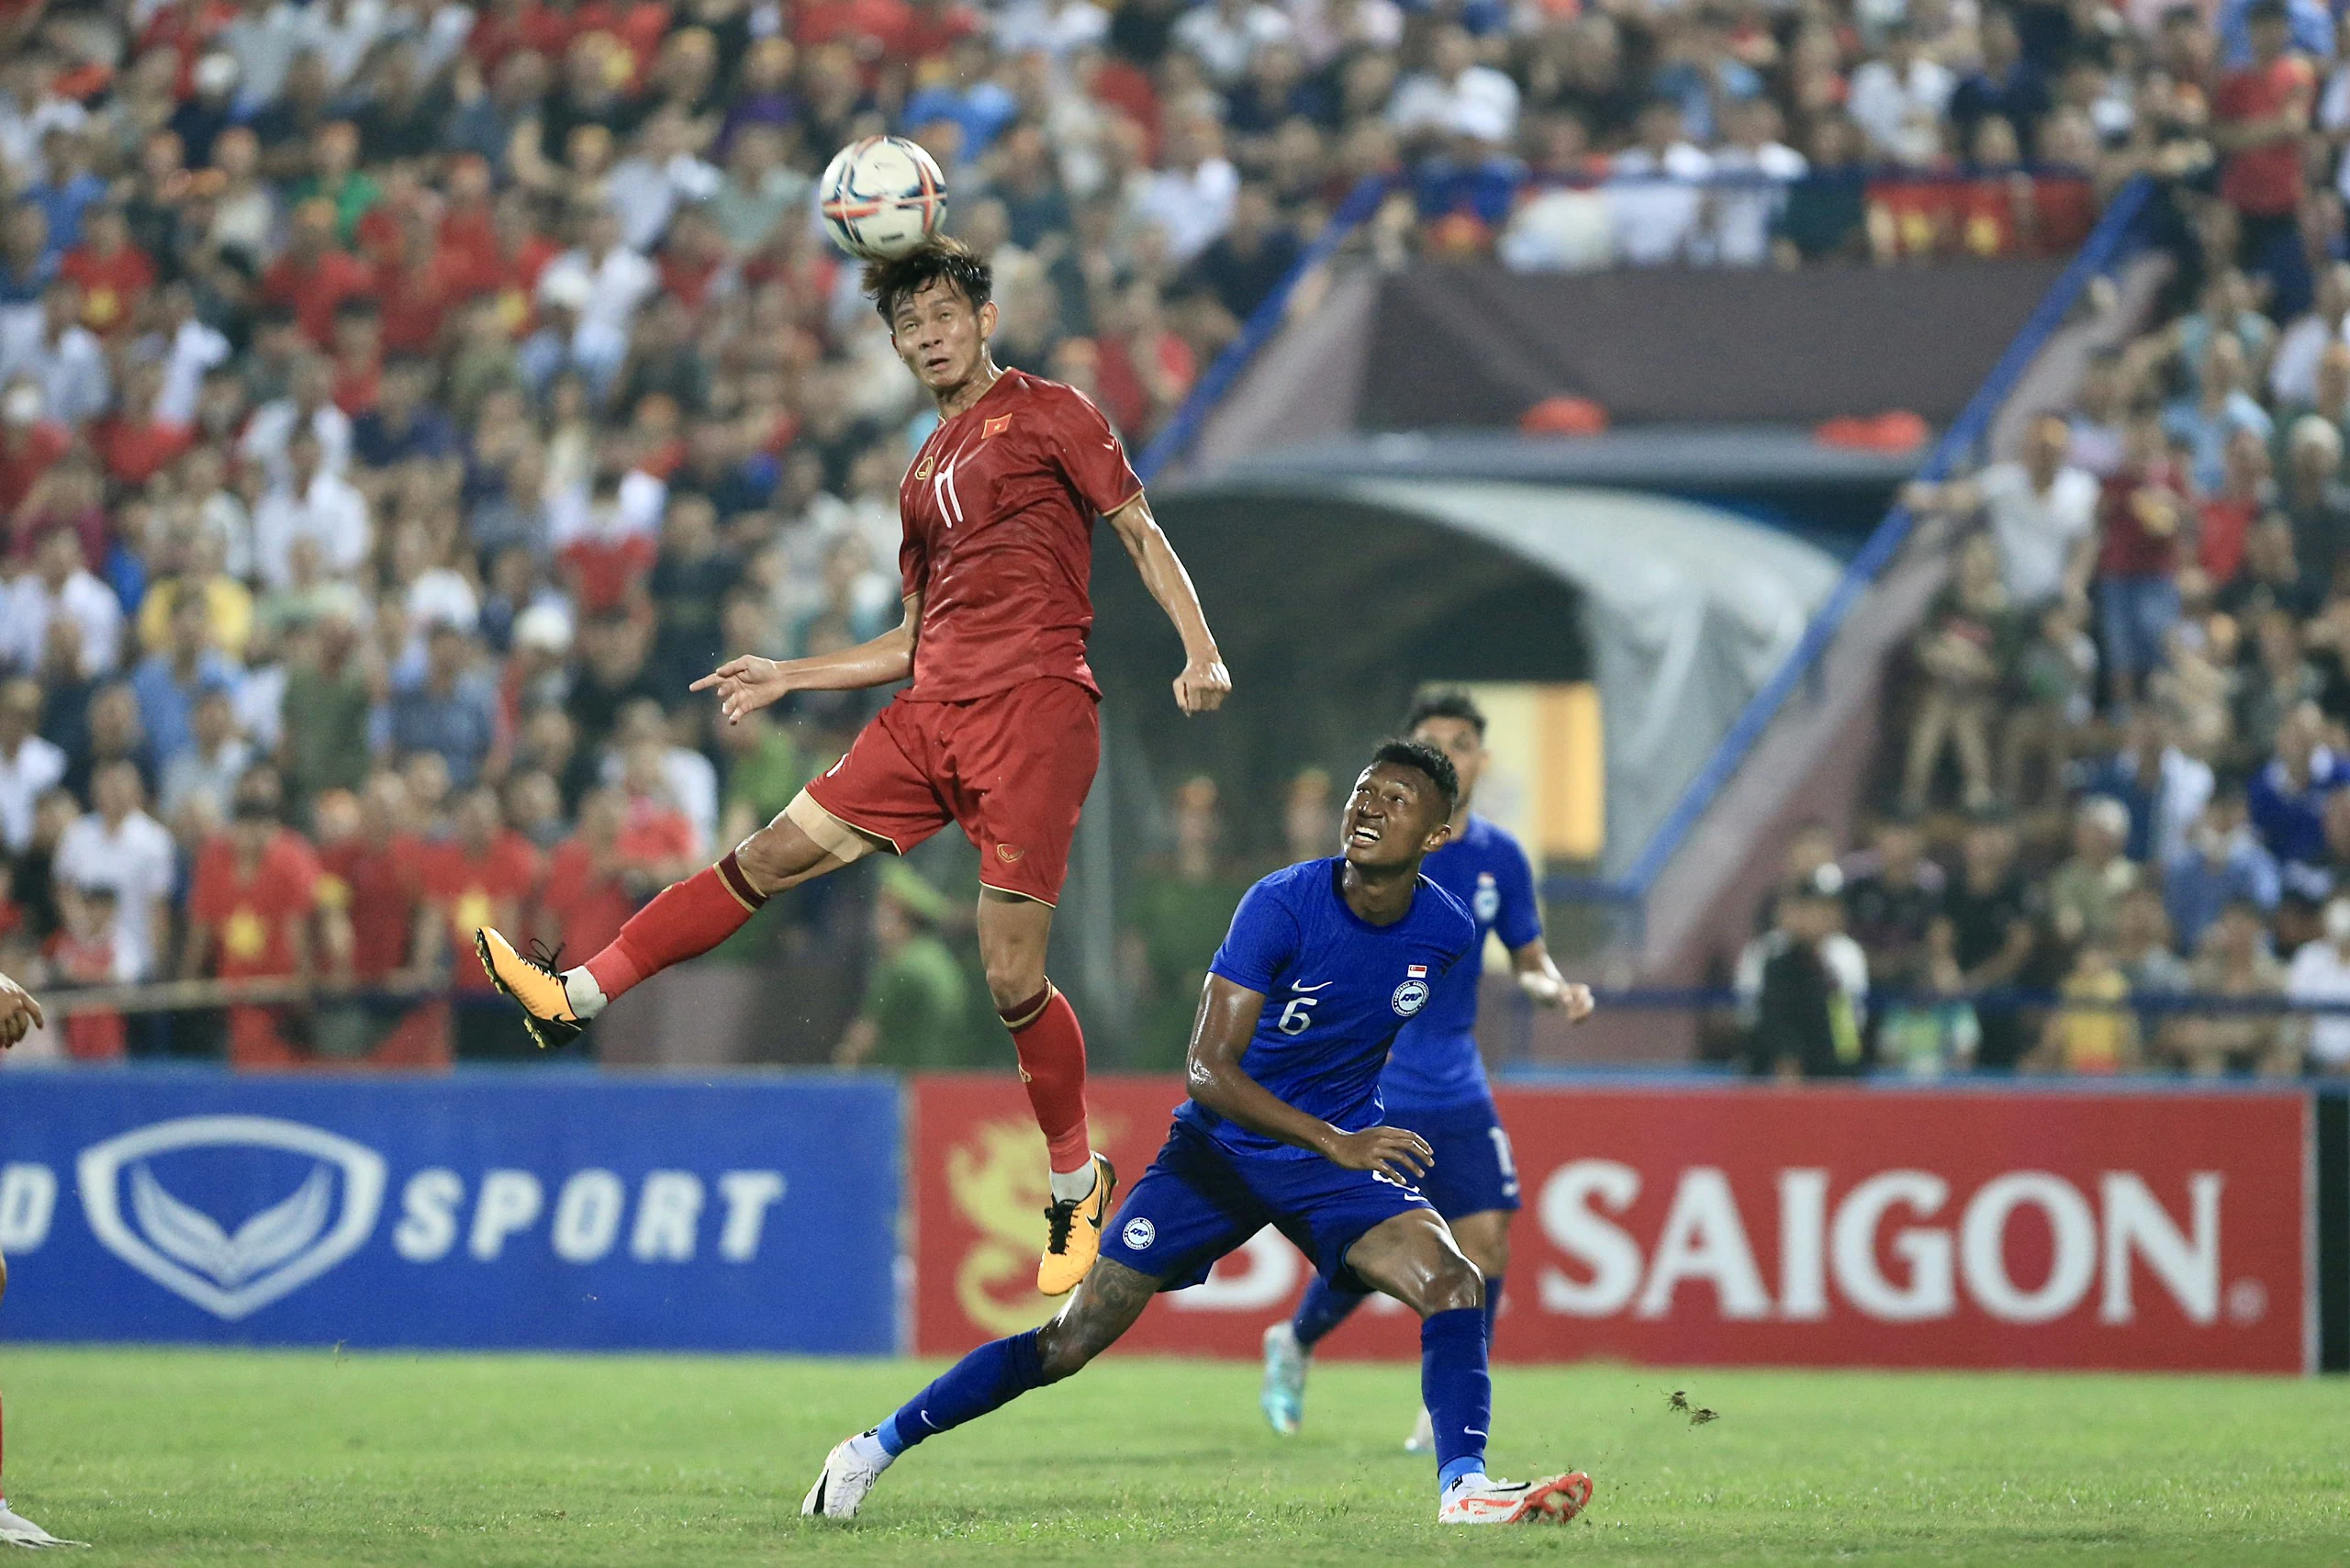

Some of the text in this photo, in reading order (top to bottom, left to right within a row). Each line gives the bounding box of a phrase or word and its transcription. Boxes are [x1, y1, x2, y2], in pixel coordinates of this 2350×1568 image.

[934, 464, 964, 529] 11
[1278, 997, 1318, 1036] 6
[392, 1167, 789, 1263] SPORT
[1537, 1158, 2223, 1325] SAIGON
